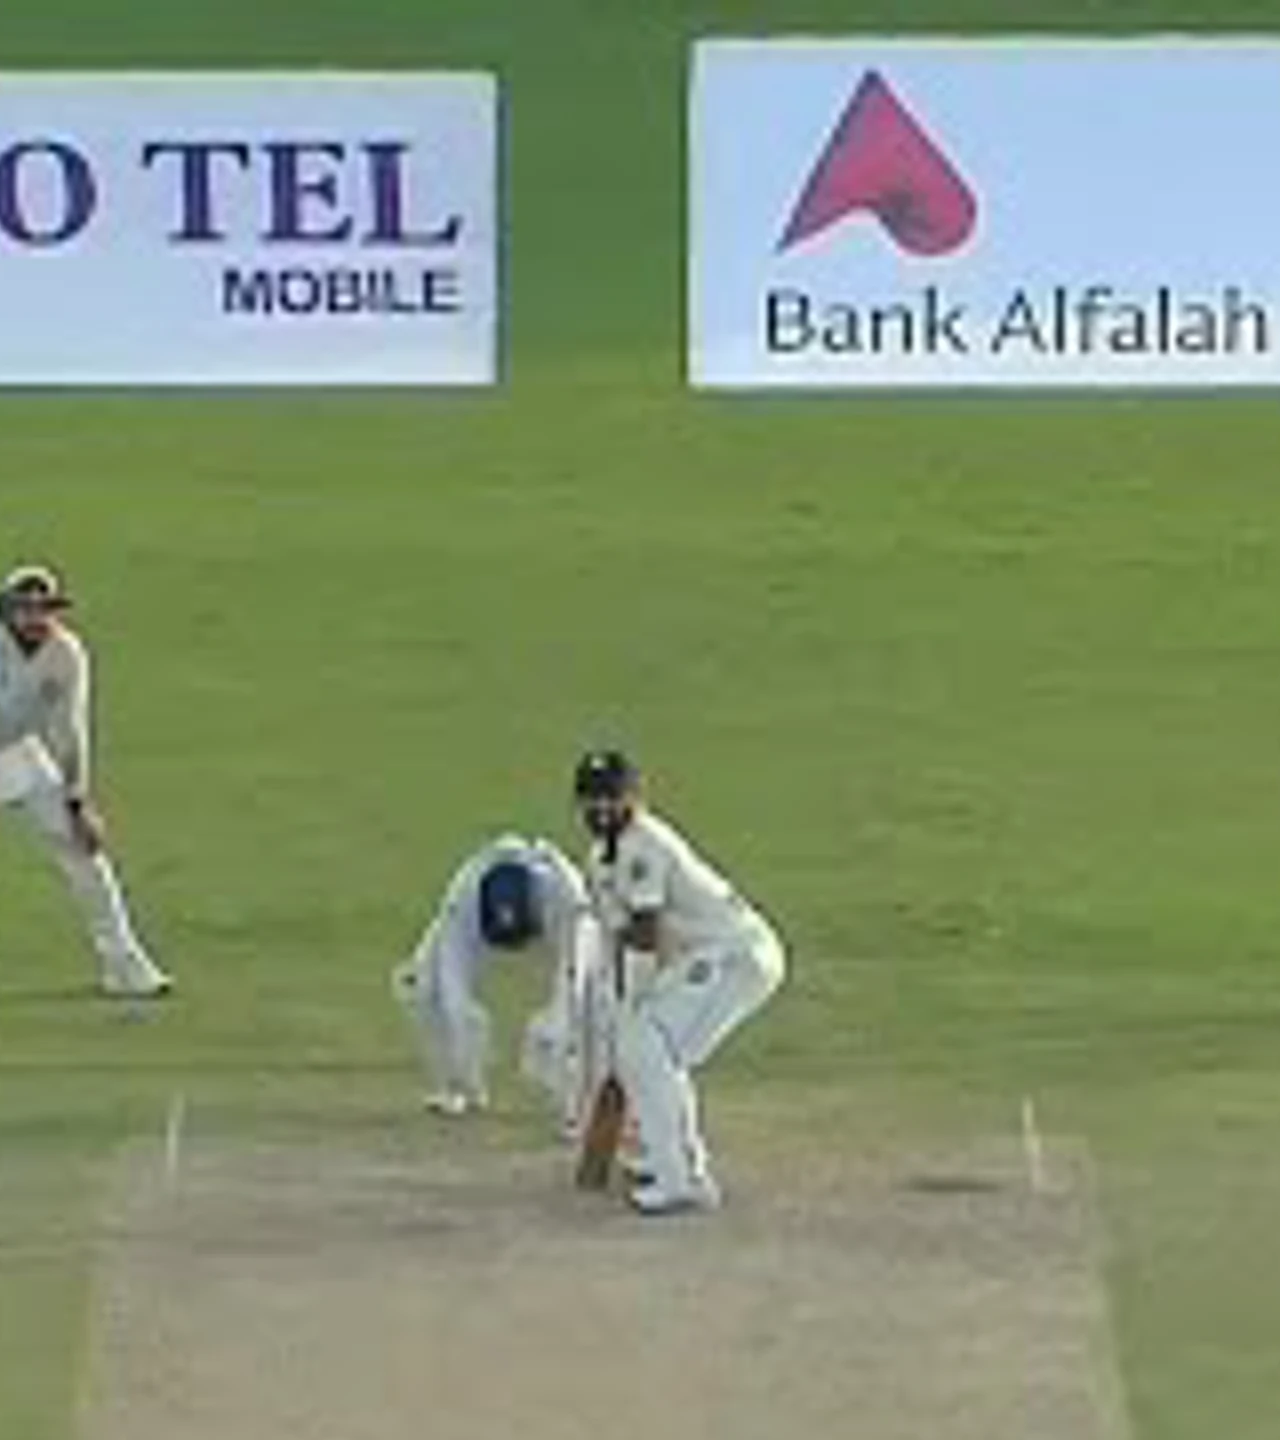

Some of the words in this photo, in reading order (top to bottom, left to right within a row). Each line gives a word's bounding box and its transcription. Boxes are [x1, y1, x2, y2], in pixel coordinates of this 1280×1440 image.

[140, 141, 463, 247] TEL
[222, 269, 461, 315] MOBILE
[765, 287, 969, 355] Bank
[991, 287, 1271, 355] Alfalah
